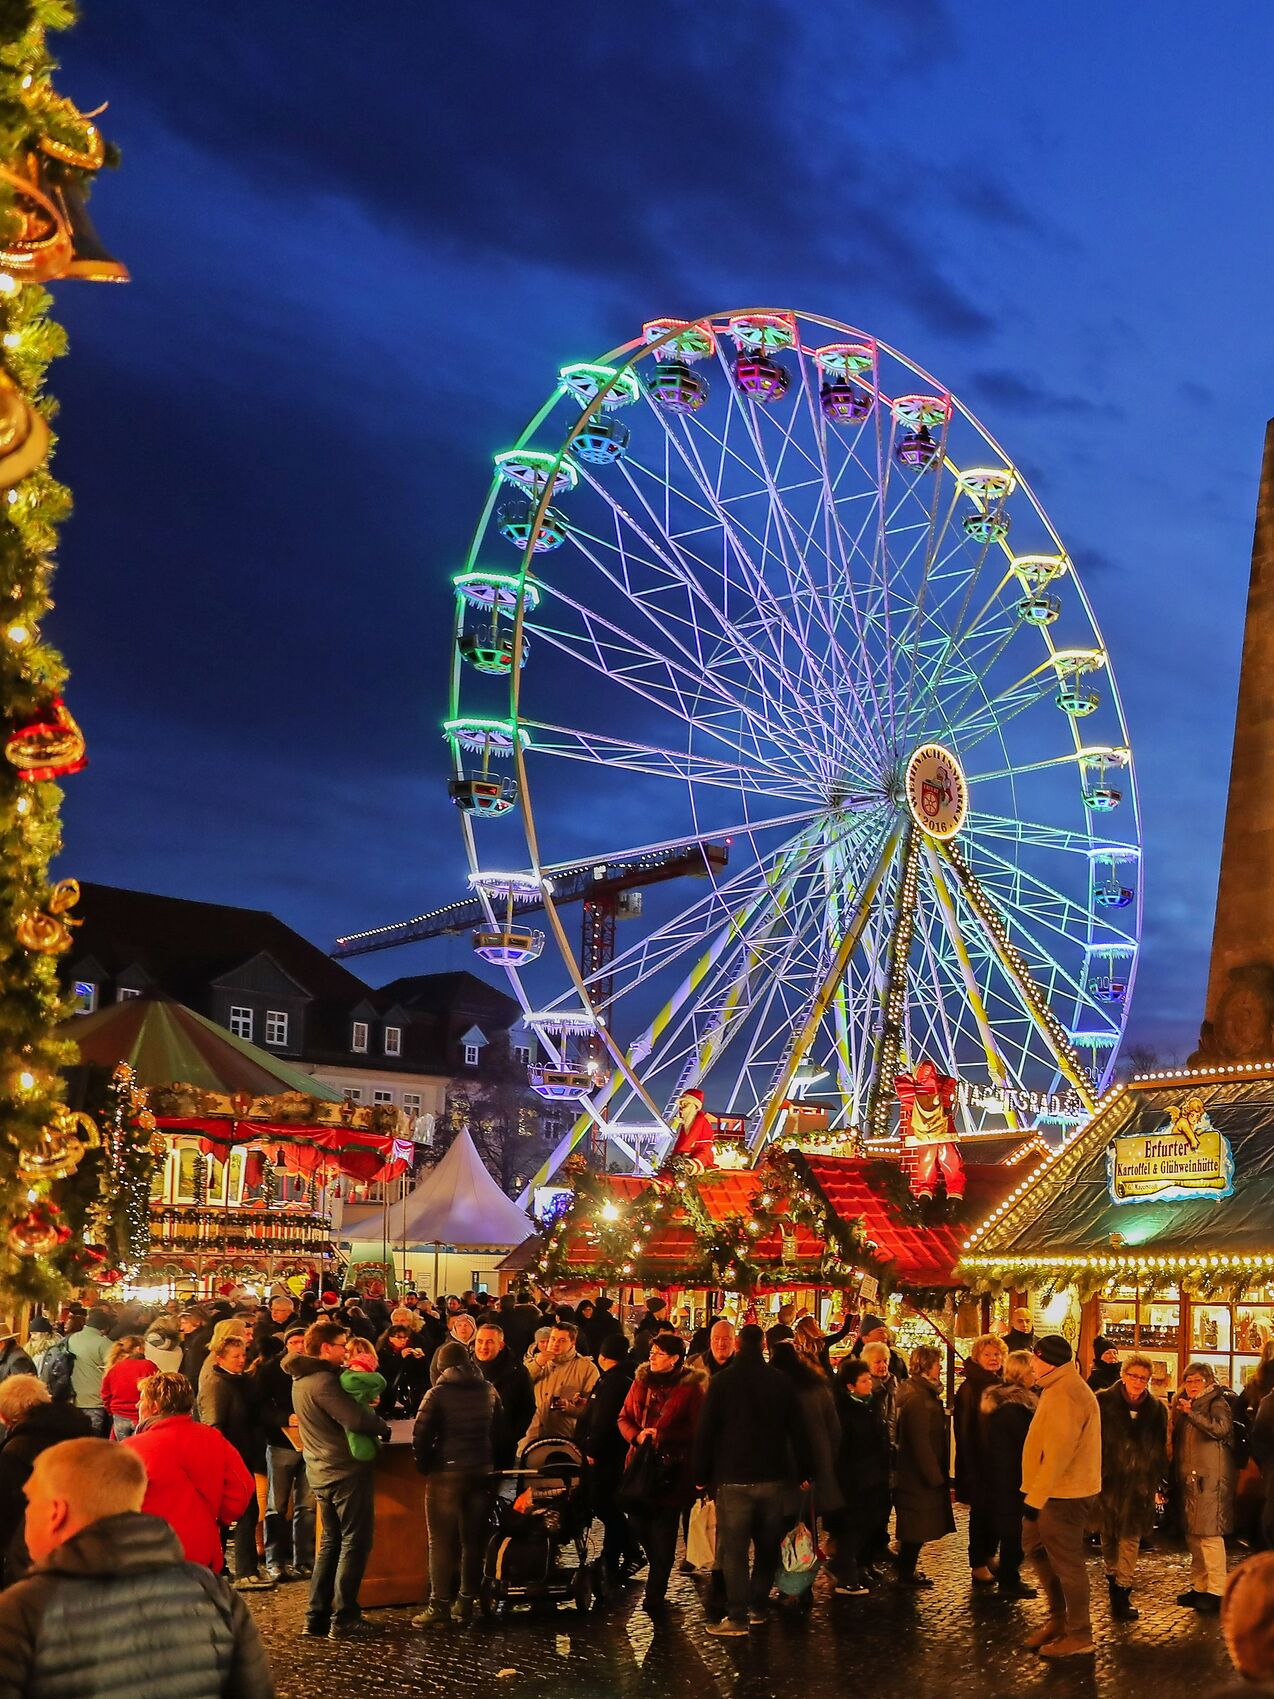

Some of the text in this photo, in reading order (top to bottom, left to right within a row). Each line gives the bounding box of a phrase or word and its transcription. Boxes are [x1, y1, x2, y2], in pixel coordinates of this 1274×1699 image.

[909, 748, 963, 823] WEIHNACHTSMARKT
[922, 816, 947, 833] 2016
[1144, 1140, 1188, 1158] Erfurter
[1117, 1158, 1219, 1176] Kartoffel & Glühweinhütte
